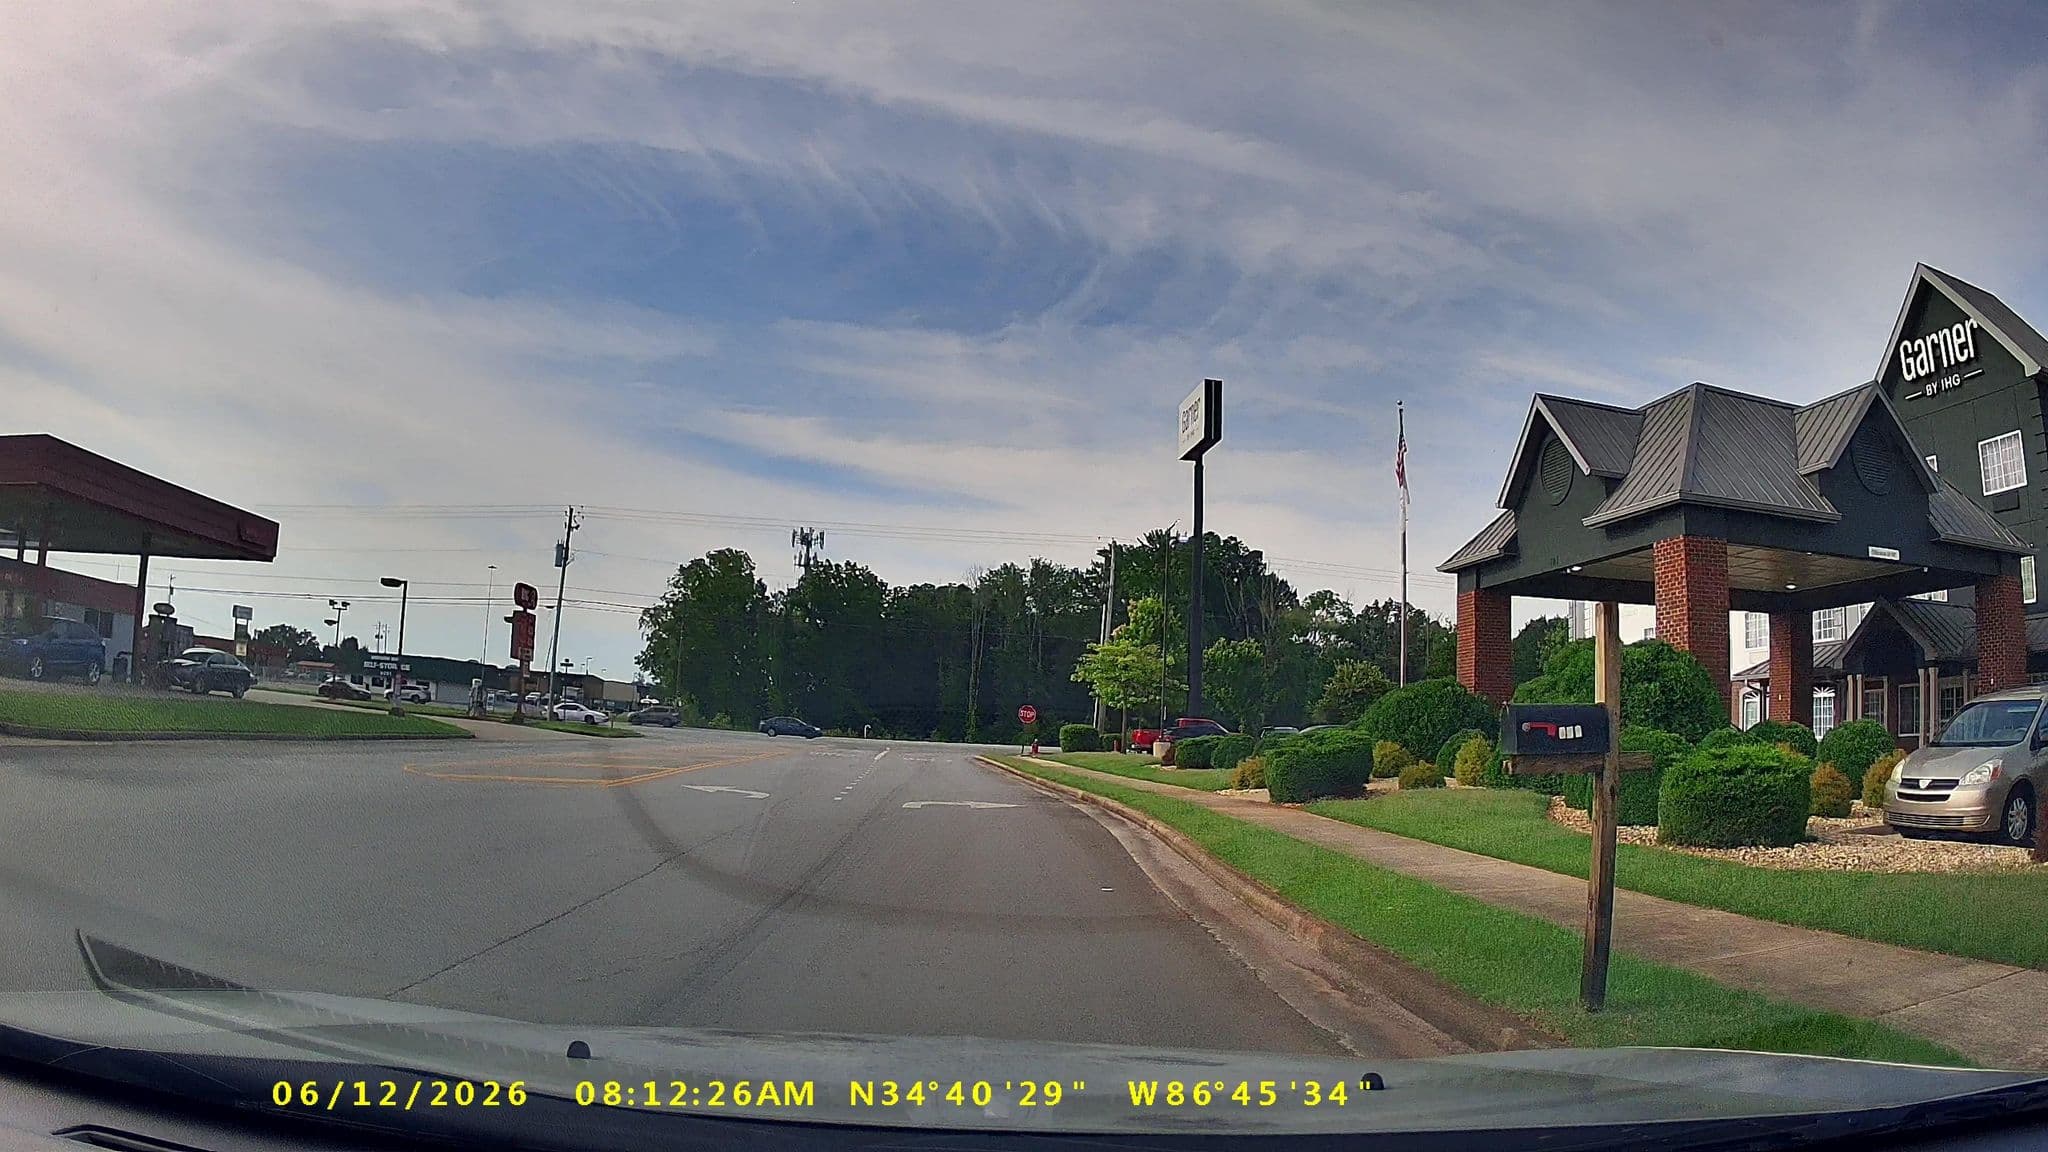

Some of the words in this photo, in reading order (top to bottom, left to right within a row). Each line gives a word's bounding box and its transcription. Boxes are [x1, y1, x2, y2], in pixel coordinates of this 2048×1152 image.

[1899, 318, 1978, 382] Garner
[1925, 381, 1938, 396] BY
[1940, 373, 1961, 391] IHG
[1020, 710, 1034, 718] STOP
